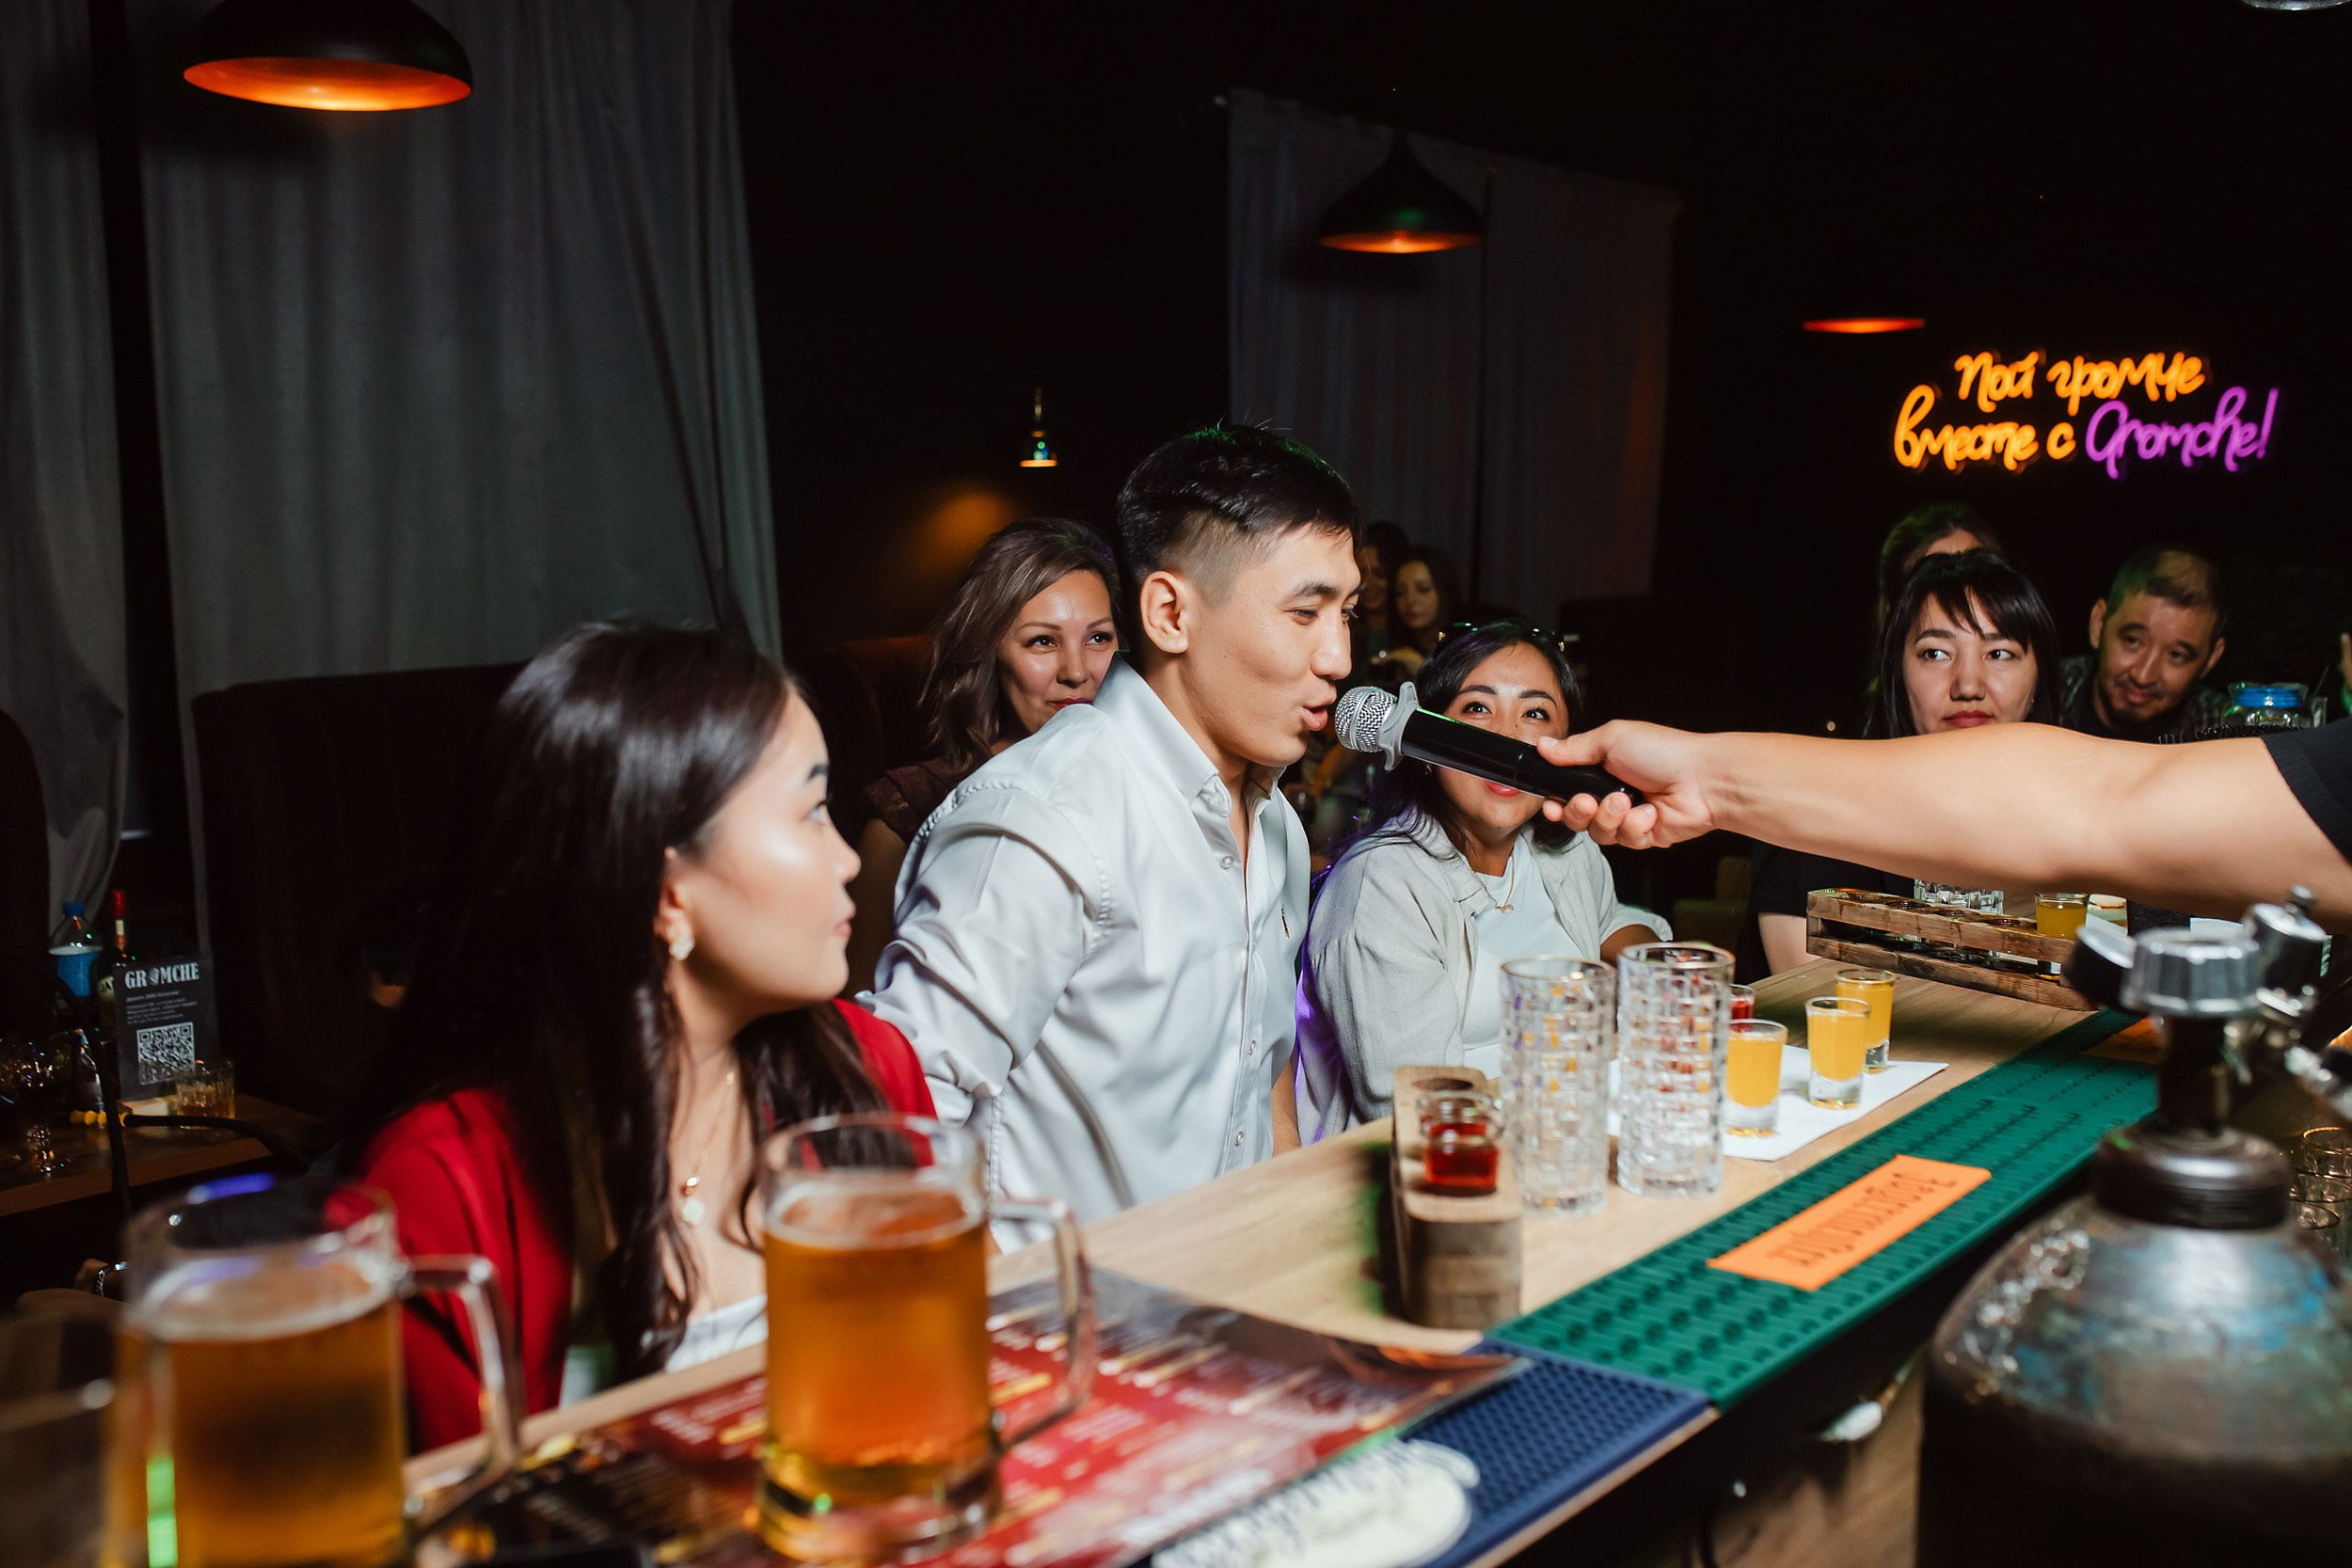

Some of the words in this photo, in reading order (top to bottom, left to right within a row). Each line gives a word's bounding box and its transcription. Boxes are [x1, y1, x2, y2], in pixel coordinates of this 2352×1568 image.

[1954, 352, 2040, 413] Пой
[2046, 352, 2206, 416] громче
[1894, 385, 2039, 470] вместе
[2086, 387, 2279, 479] Gromche!
